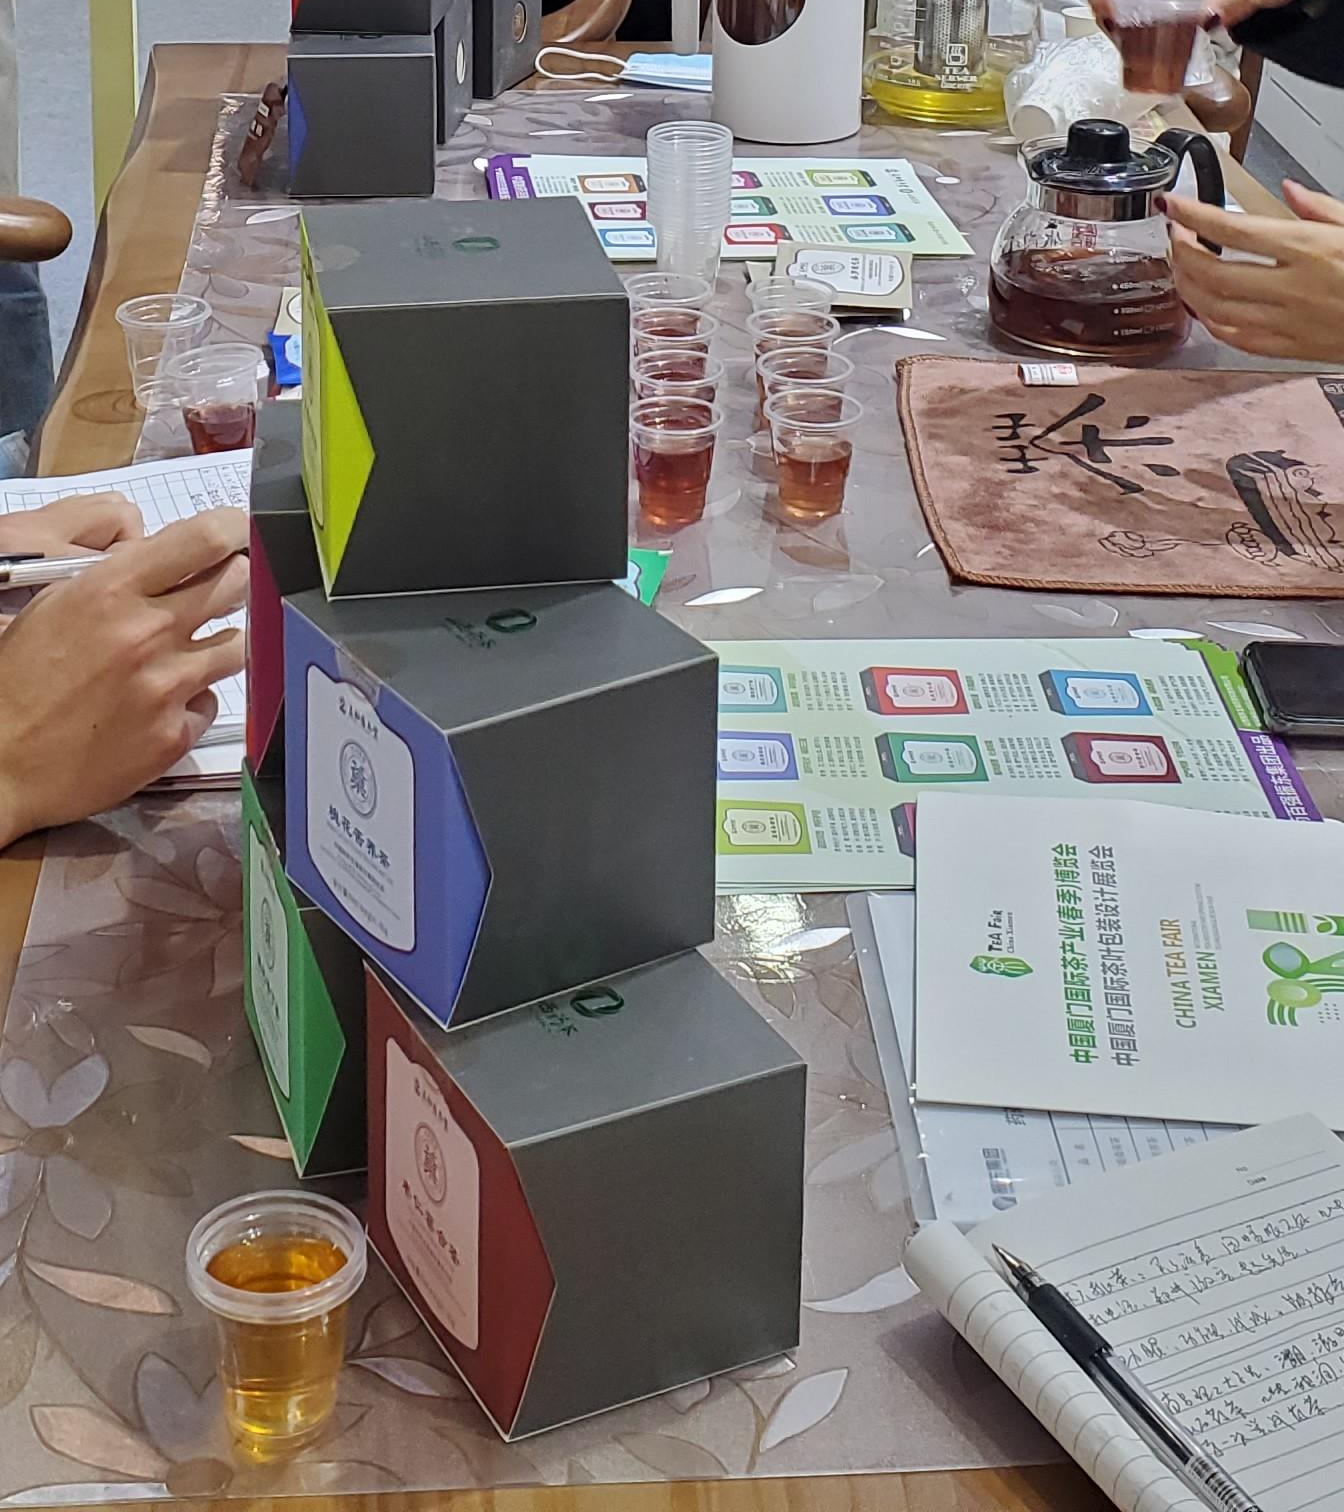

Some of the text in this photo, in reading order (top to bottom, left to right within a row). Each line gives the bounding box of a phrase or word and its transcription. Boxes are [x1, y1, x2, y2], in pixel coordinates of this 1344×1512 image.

[1051, 842, 1099, 1064] 中国厦门国际茶产业(春季)博览会
[1088, 844, 1141, 1067] 中国厦门国际茶叶包装设计展览会
[1160, 918, 1198, 1029] CHINA TEA FAIR
[1196, 951, 1225, 1011] XIAMEN
